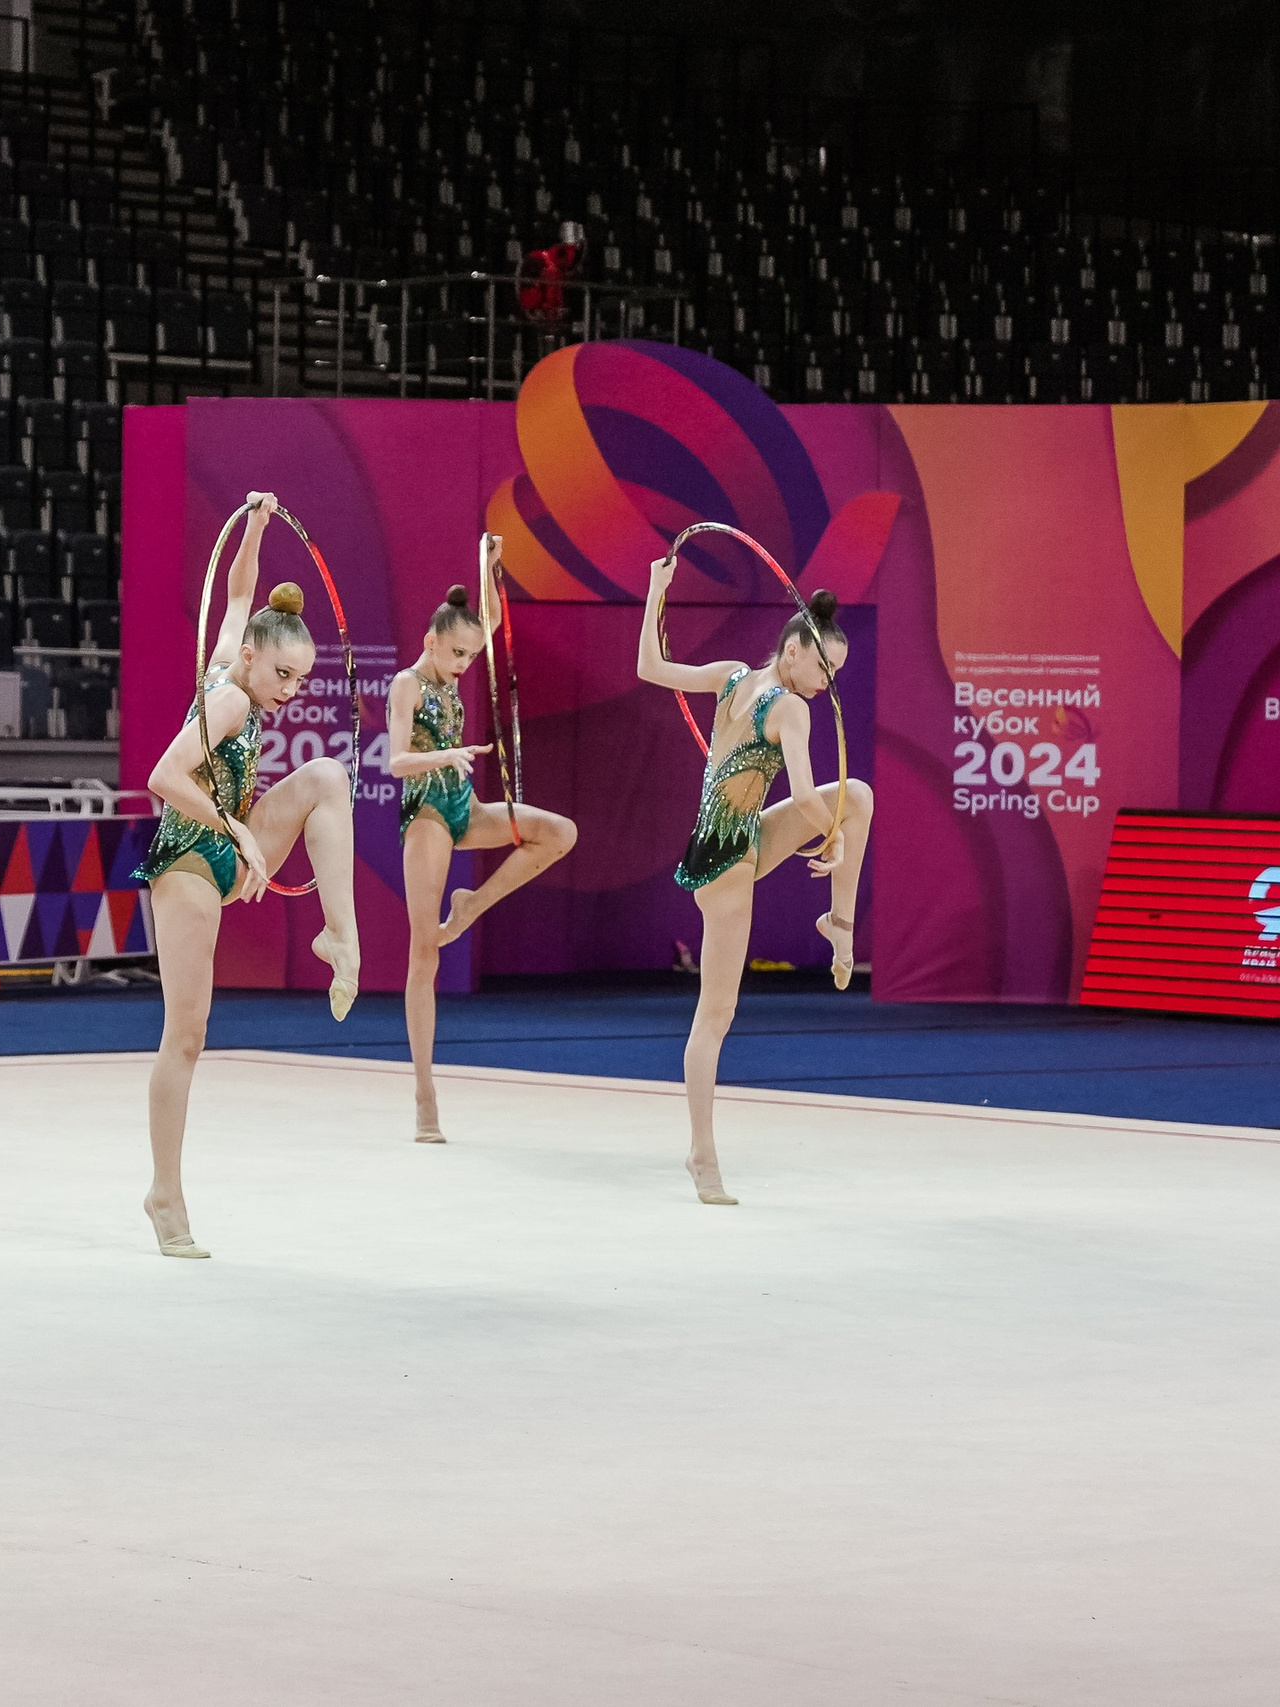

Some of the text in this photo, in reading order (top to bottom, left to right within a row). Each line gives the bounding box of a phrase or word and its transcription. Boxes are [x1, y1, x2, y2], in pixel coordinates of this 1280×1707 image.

[954, 681, 1101, 707] Весенний
[953, 709, 1040, 740] кубок
[953, 740, 1101, 787] 2024
[953, 788, 1100, 819] Spring Cup
